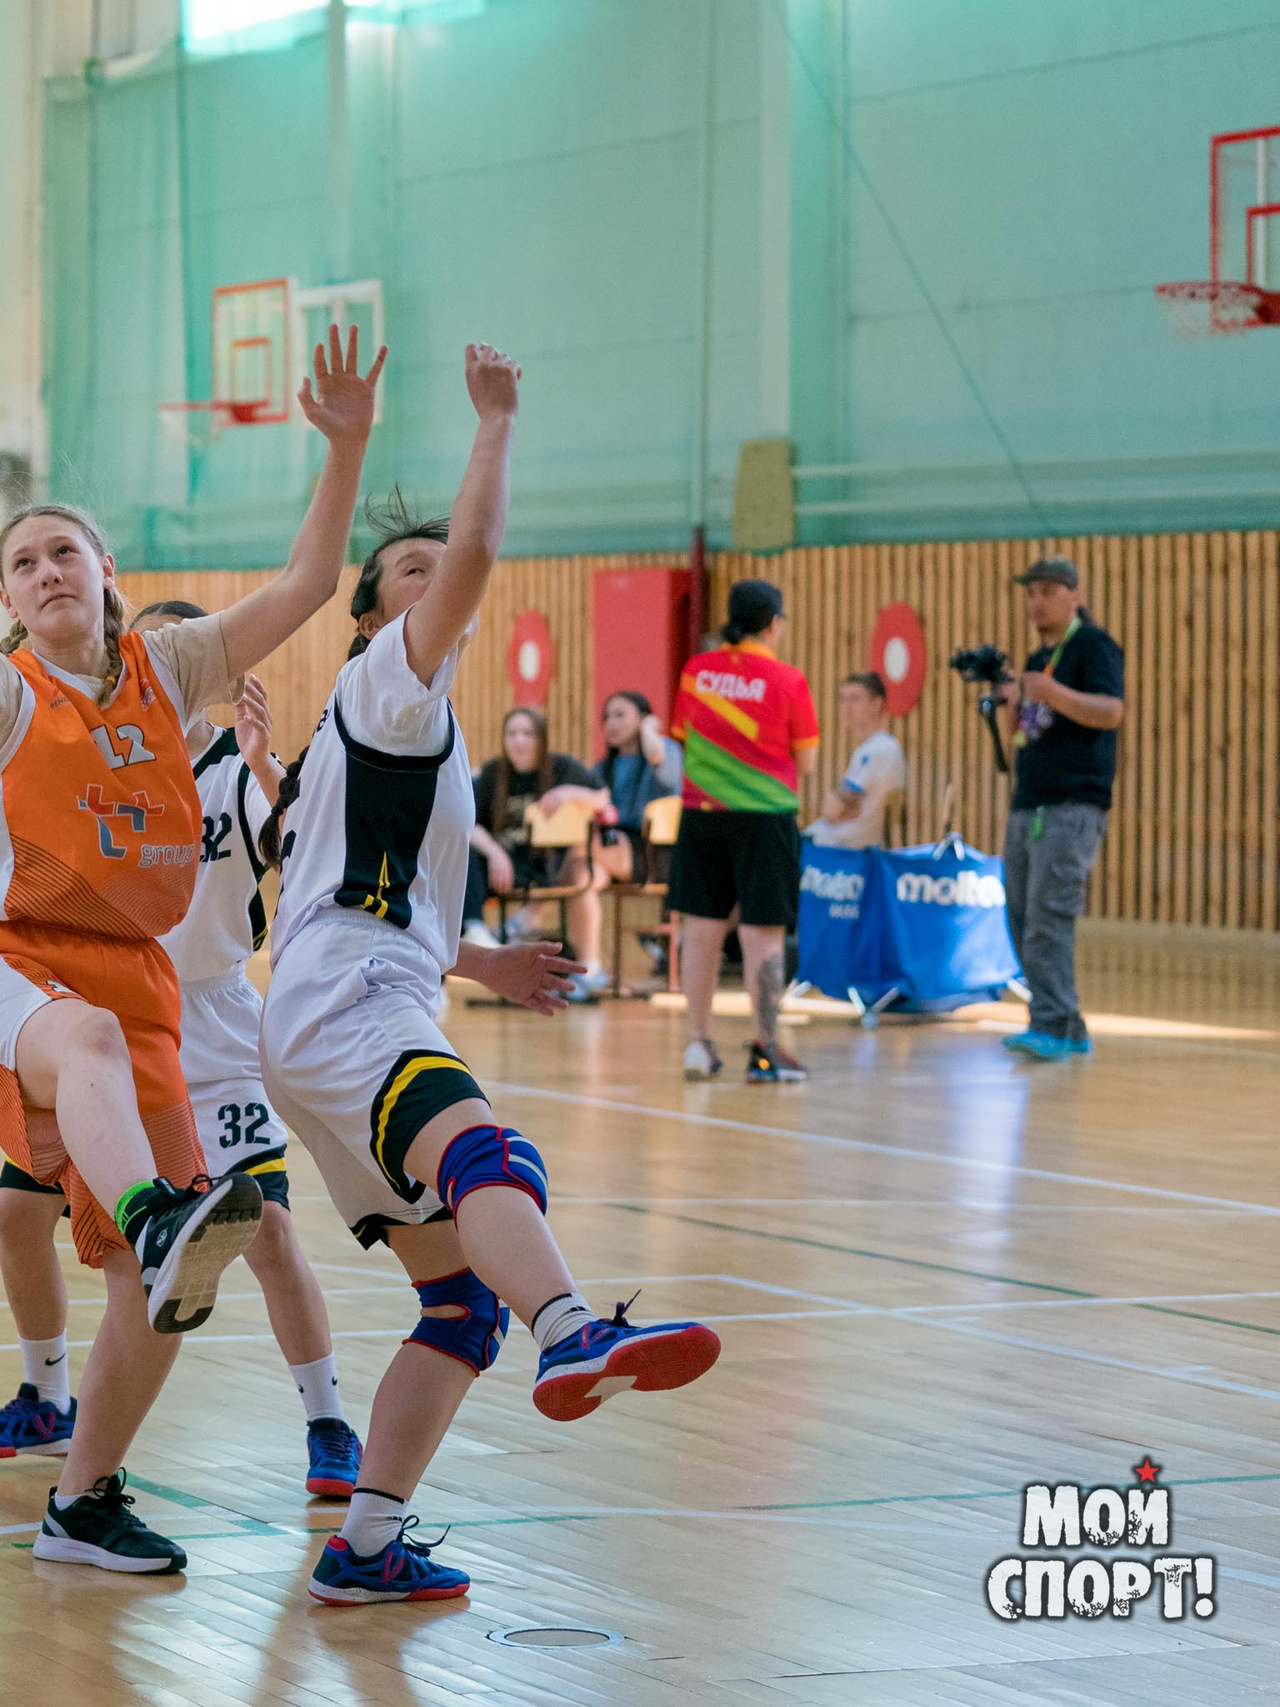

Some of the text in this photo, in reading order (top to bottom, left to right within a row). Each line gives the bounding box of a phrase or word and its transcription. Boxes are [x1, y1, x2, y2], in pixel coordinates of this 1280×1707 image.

[696, 669, 766, 703] СУДЬЯ
[90, 723, 157, 770] 12
[138, 843, 196, 868] group
[218, 1102, 270, 1149] 32
